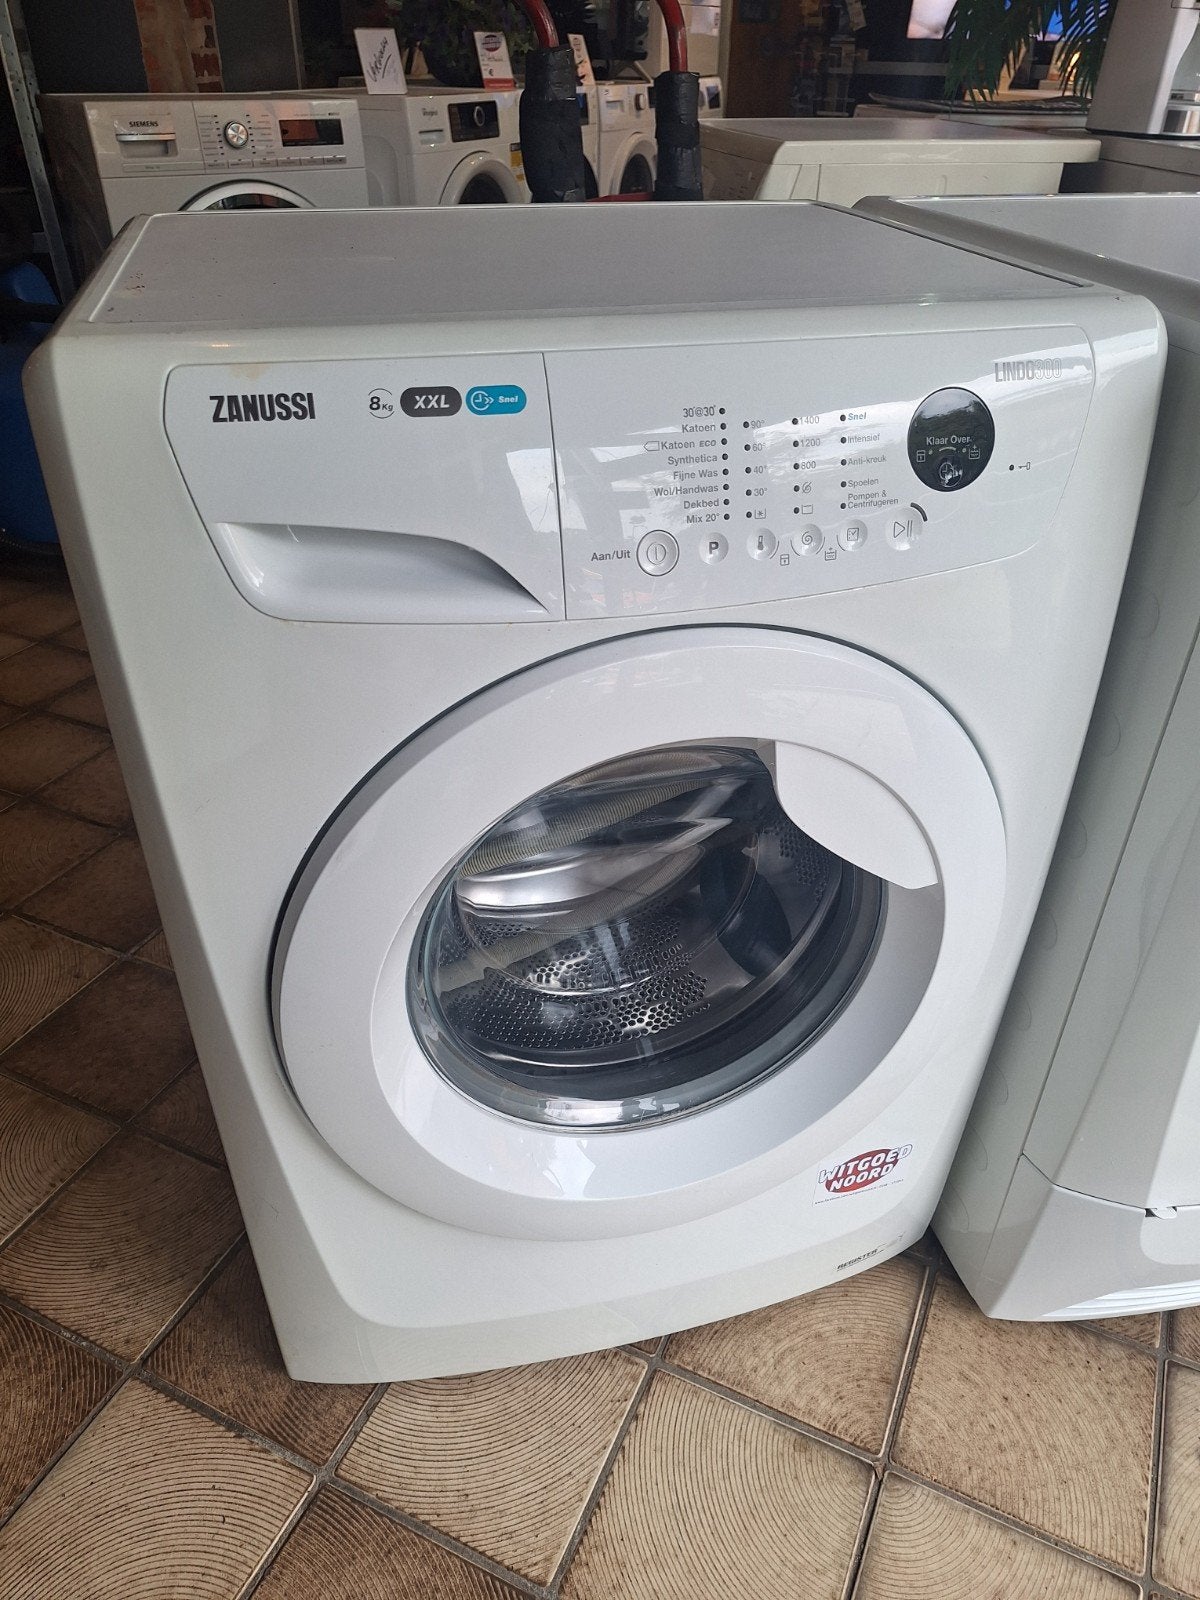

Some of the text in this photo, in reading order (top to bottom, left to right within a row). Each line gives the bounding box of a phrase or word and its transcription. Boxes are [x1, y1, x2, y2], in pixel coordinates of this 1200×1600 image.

[994, 358, 1062, 382] LINDO300
[414, 394, 450, 410] XXL
[498, 395, 518, 404] Snel
[209, 392, 316, 423] ZANUSSI
[799, 415, 820, 425] 1400
[847, 412, 867, 421] Snel
[681, 424, 716, 433] Katoen
[661, 439, 716, 450] Katoen ECO
[800, 438, 820, 448] 1200
[847, 433, 880, 444] Intensief
[926, 434, 971, 446] Klaar Over
[667, 454, 718, 466] Synthetica
[800, 460, 816, 470] 800
[847, 455, 887, 466] Anti-kreuk
[673, 469, 719, 481] Fijne Was
[847, 478, 879, 489] Spoelen
[653, 484, 719, 496] Wol/Handwas
[753, 487, 767, 497] 30°
[847, 490, 887, 503] Pompen &
[683, 498, 719, 509] Dekbed
[847, 498, 899, 510] Centrifugeren
[686, 512, 720, 524] Mix 20°
[708, 541, 719, 555] P
[590, 549, 631, 562] Aan/Uit
[817, 1143, 913, 1184] WITGOED
[828, 1163, 895, 1192] NOORD
